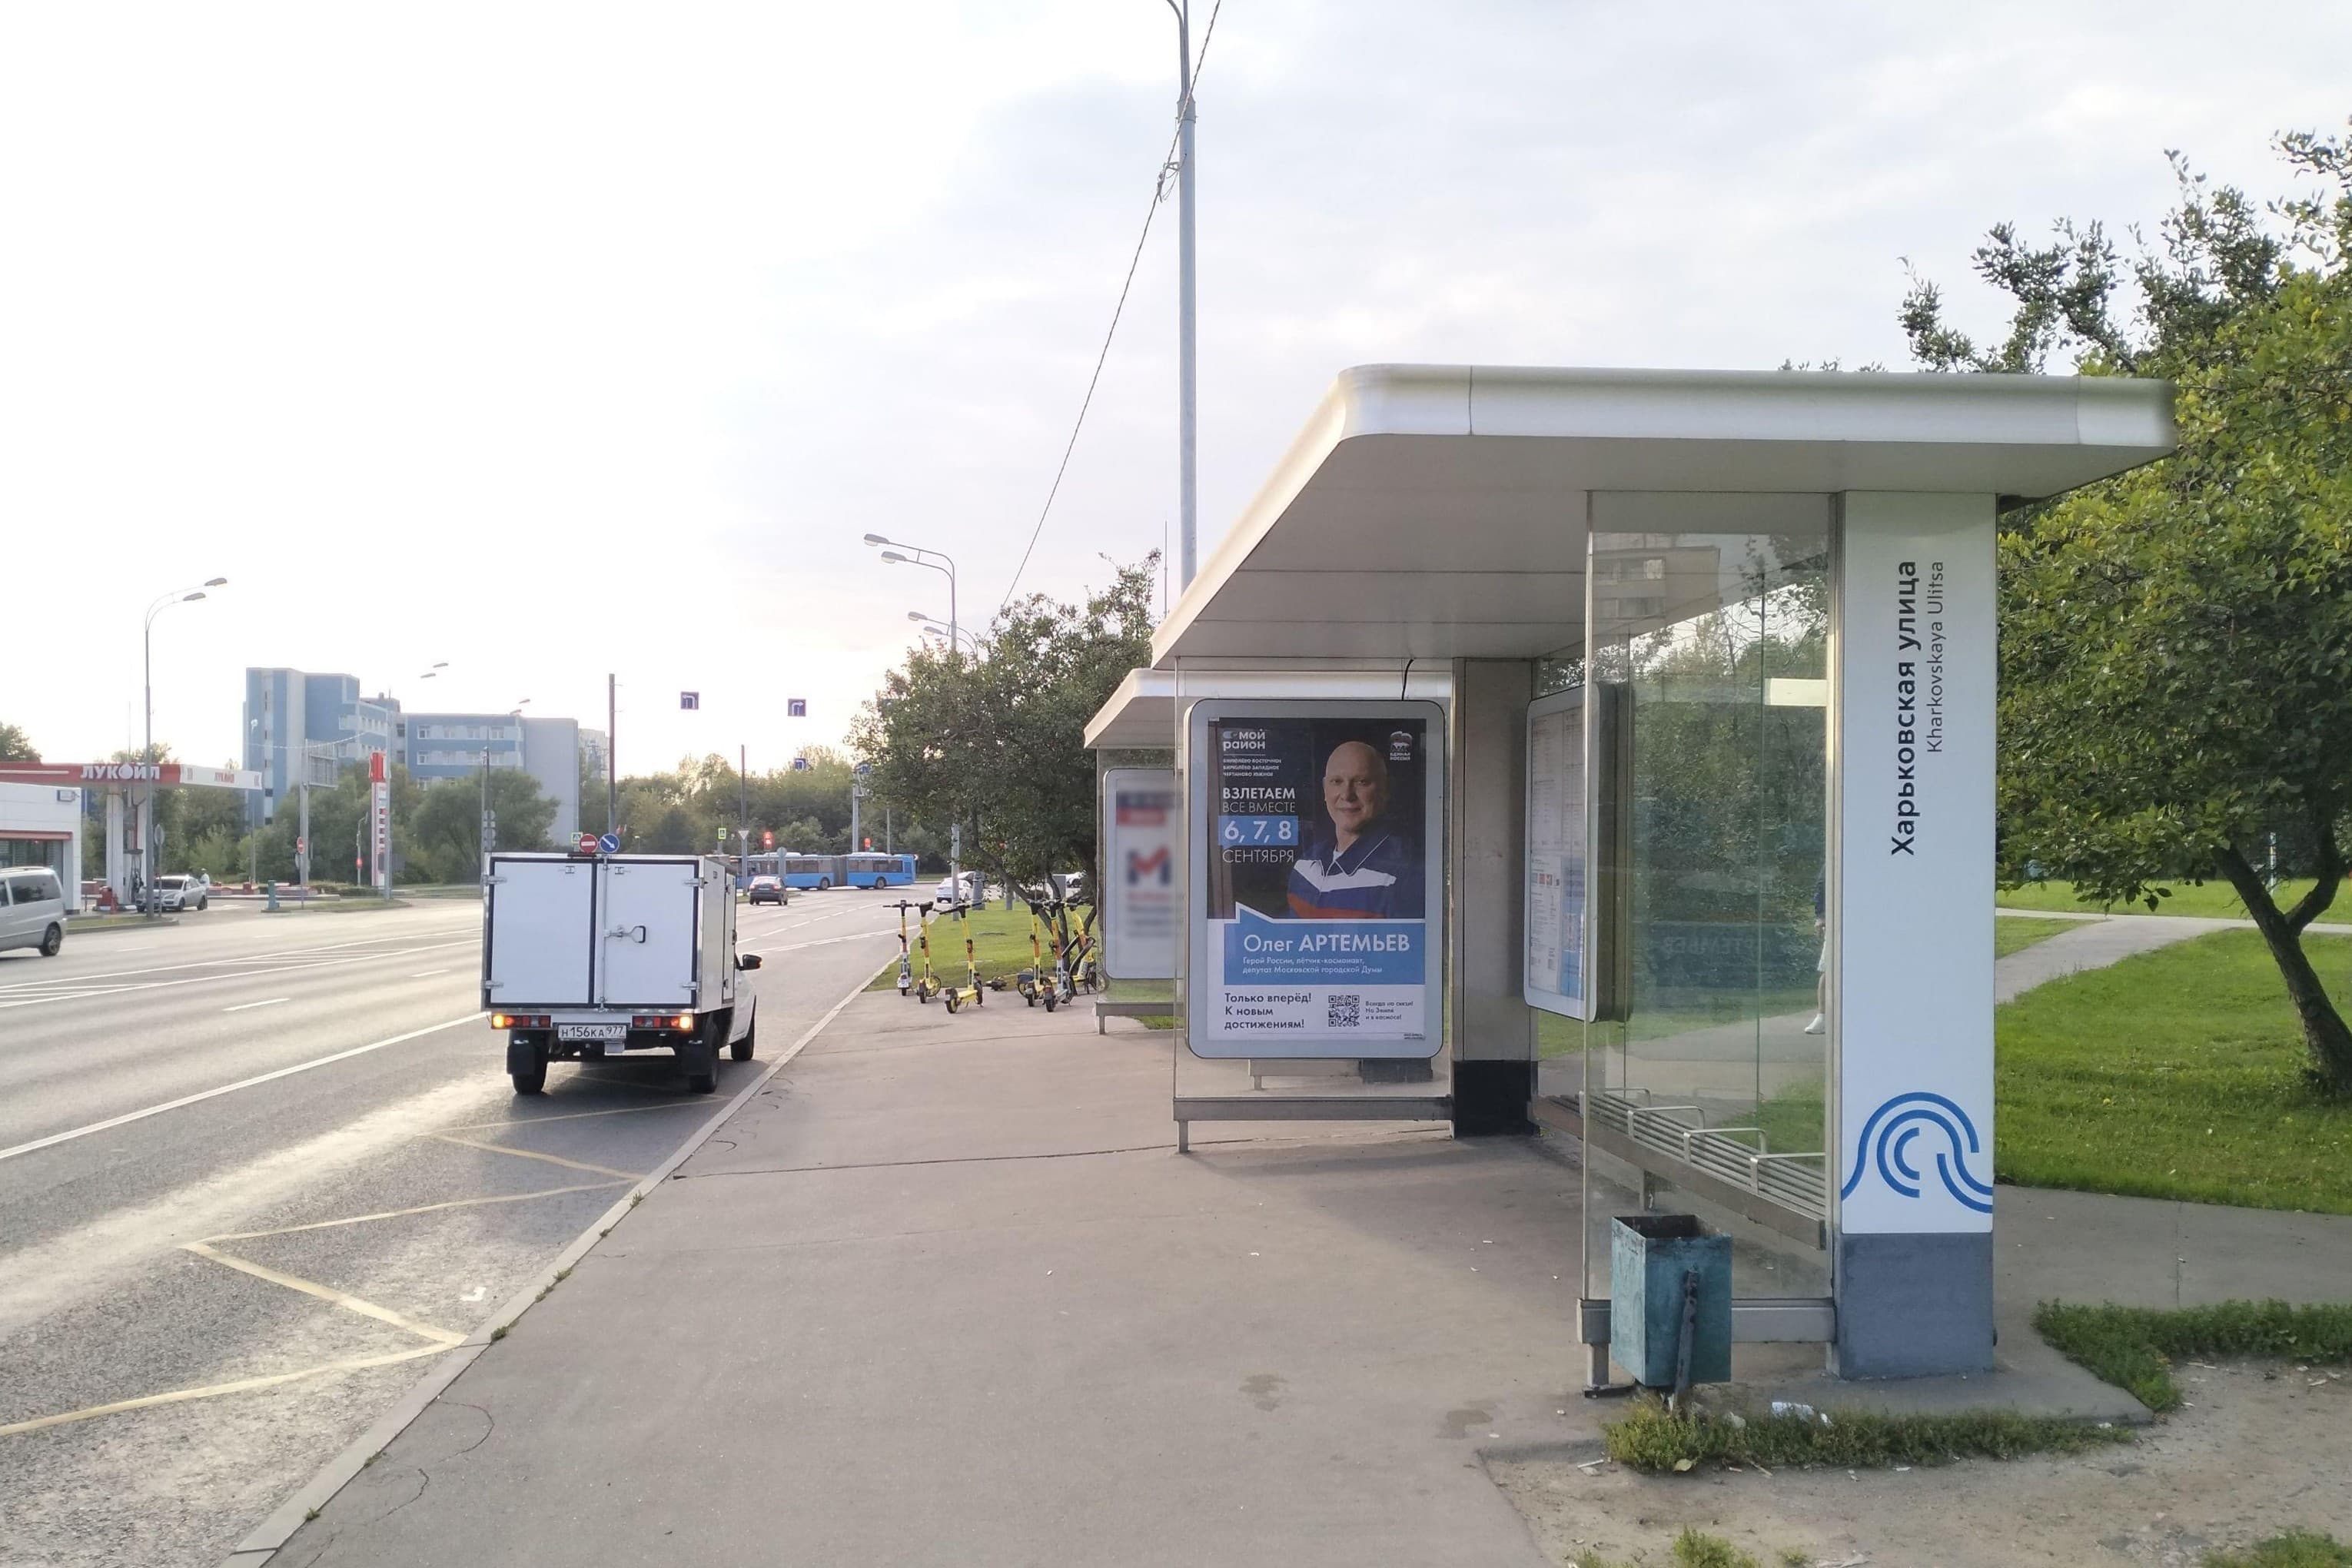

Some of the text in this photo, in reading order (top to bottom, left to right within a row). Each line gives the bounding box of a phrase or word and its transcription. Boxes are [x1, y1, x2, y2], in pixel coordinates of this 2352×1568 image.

[1926, 562, 1946, 752] Kharkovskaya Ulitsa
[1892, 562, 1922, 855] Харьковская улица
[1223, 787, 1295, 799] ВЗЛЕТАЕМ
[1223, 802, 1295, 812] ВСЕ ВМЕСТЕ
[1224, 820, 1291, 843] 6, 7, 8
[1222, 849, 1294, 862] СЕНТЯБРЯ
[1244, 934, 1410, 952] Олег АРТЕМЬЕВ
[1321, 965, 1359, 974] городской
[1361, 965, 1383, 974] Думы
[1224, 992, 1311, 1005] Только вперёд!
[1225, 1005, 1233, 1015] К
[1224, 1018, 1304, 1030] достижениям!
